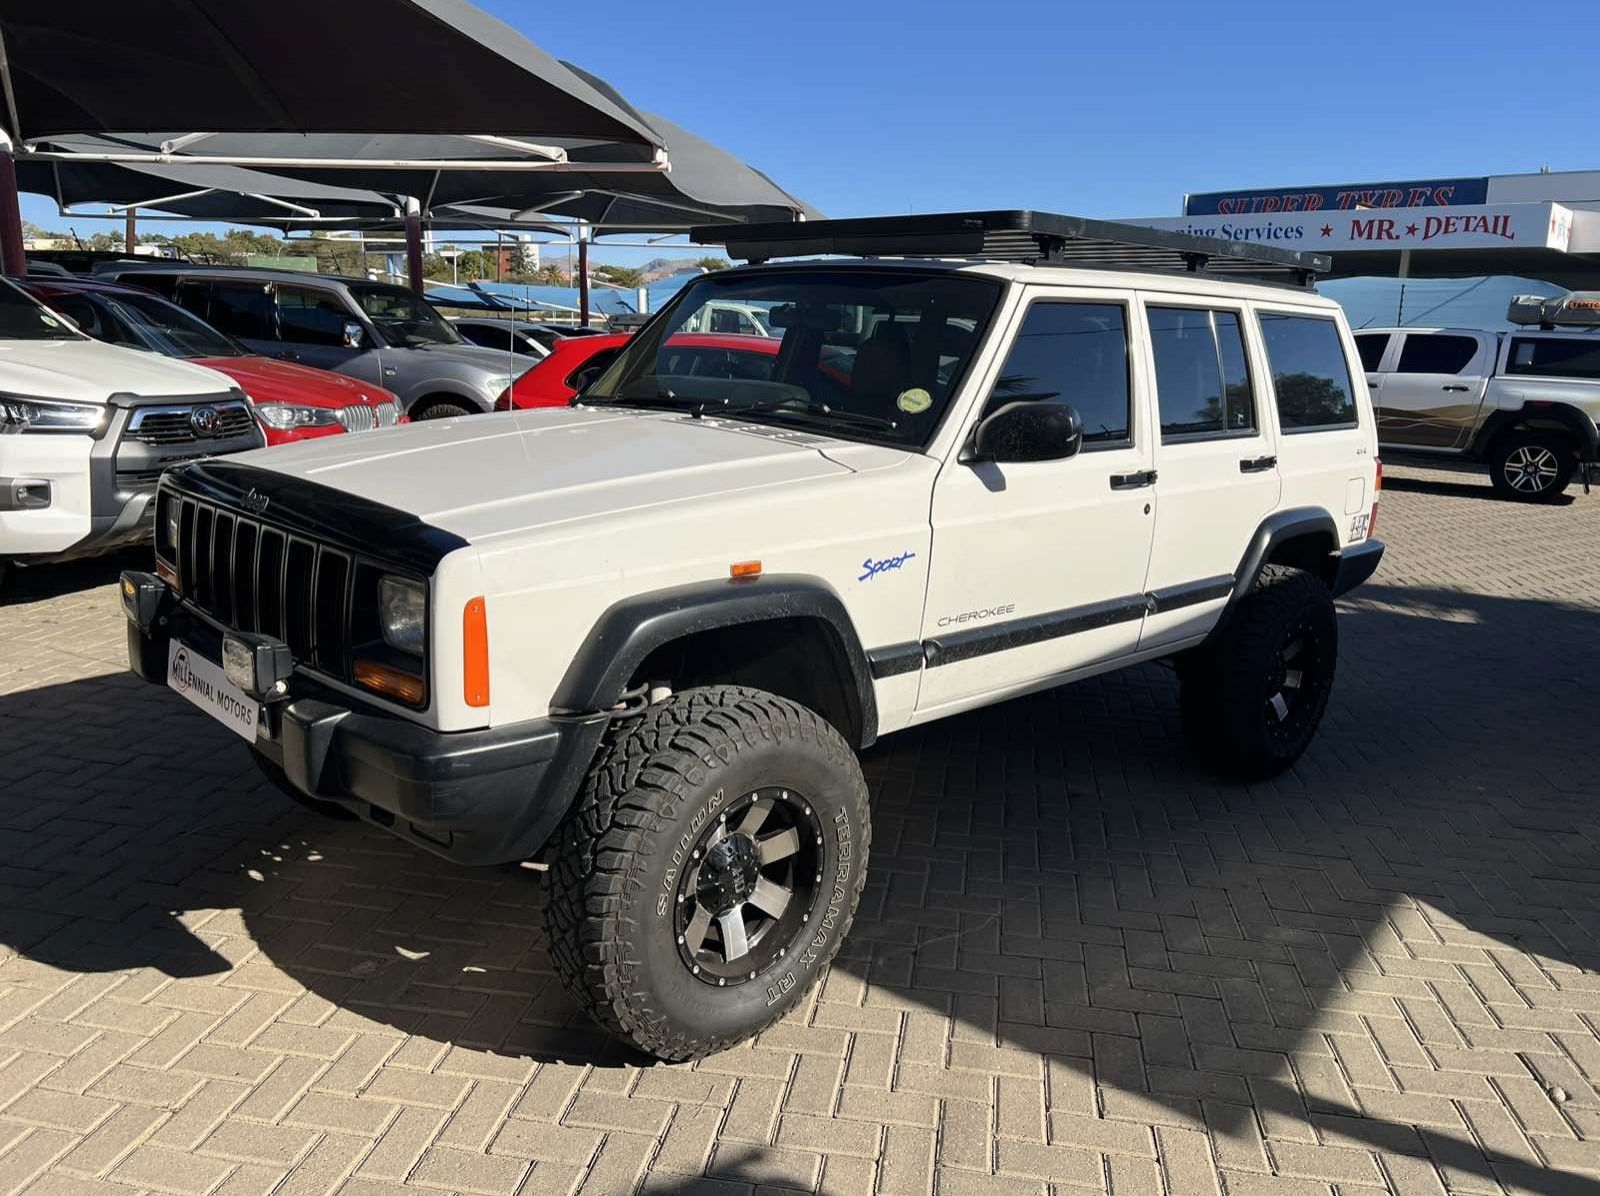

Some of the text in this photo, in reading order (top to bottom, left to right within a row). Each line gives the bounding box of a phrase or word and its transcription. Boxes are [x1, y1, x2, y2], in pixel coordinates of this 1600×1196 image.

[1221, 221, 1304, 241] Services
[1349, 219, 1400, 241] MR.
[1422, 214, 1516, 241] DETAIL
[937, 604, 1016, 627] CHEROKEE
[172, 659, 252, 725] MILLENNIAL MOTORS
[767, 806, 852, 1007] TERRAMAX RT
